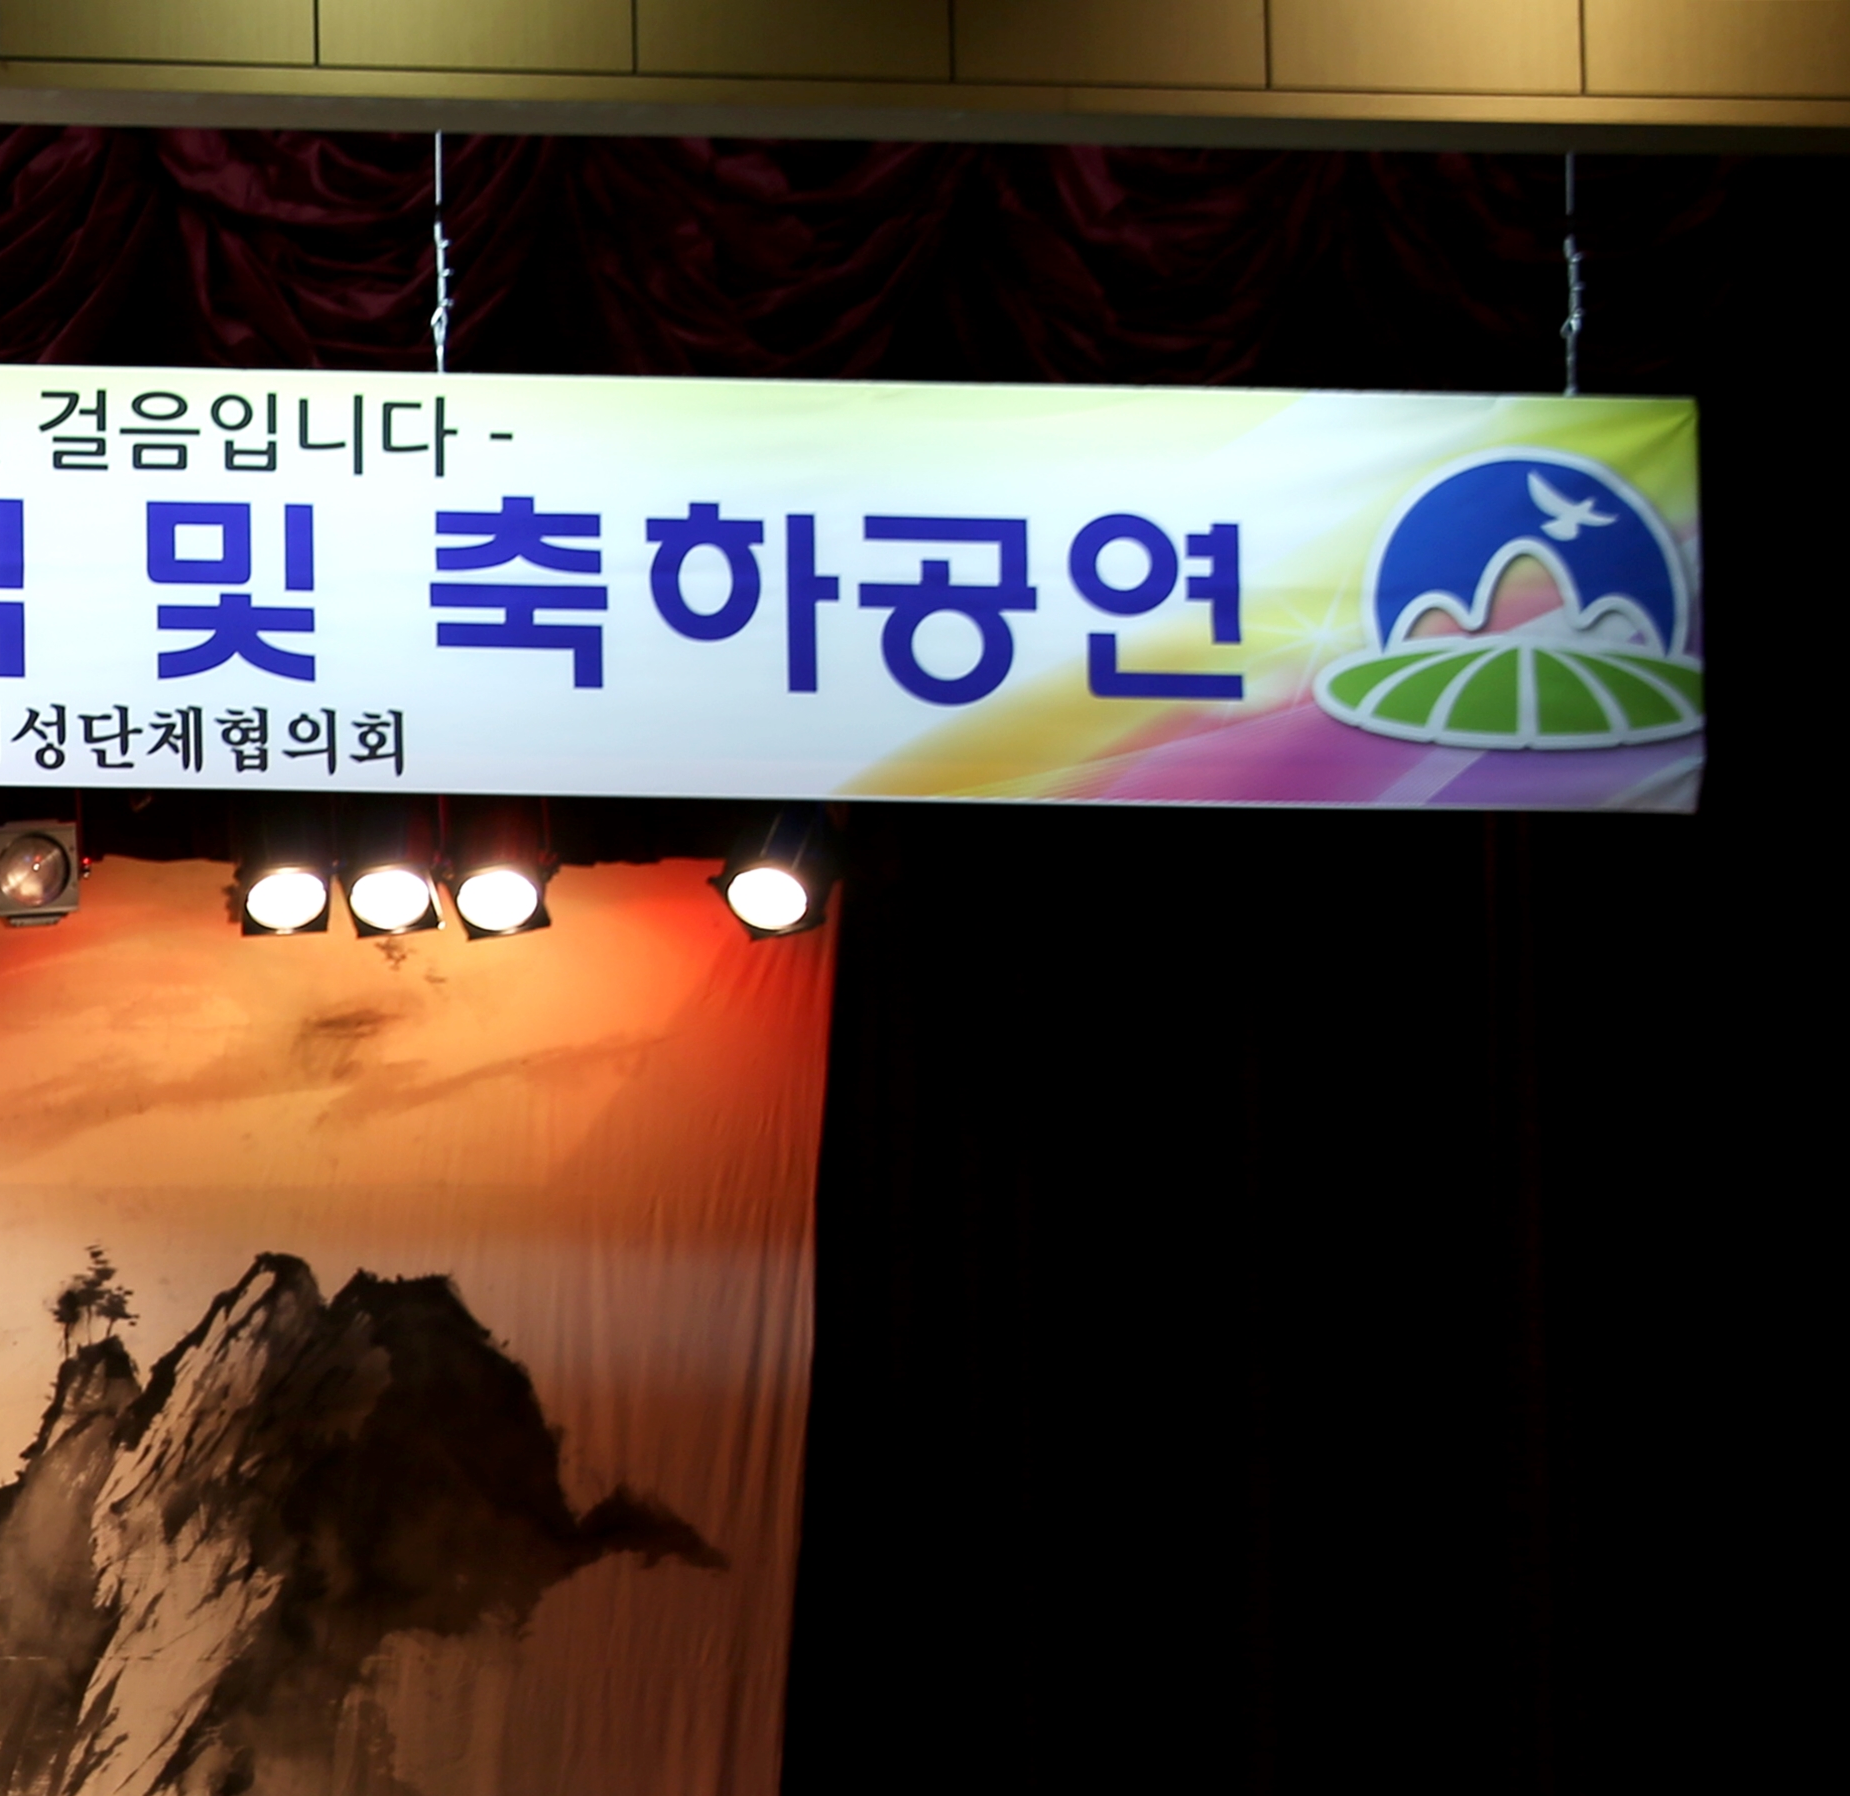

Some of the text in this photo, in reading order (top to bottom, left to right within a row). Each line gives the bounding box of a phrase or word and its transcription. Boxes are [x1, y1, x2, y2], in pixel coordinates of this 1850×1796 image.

[38, 389, 458, 478] 걸음입니다
[146, 500, 316, 683] 및
[429, 496, 1244, 706] 축하공연
